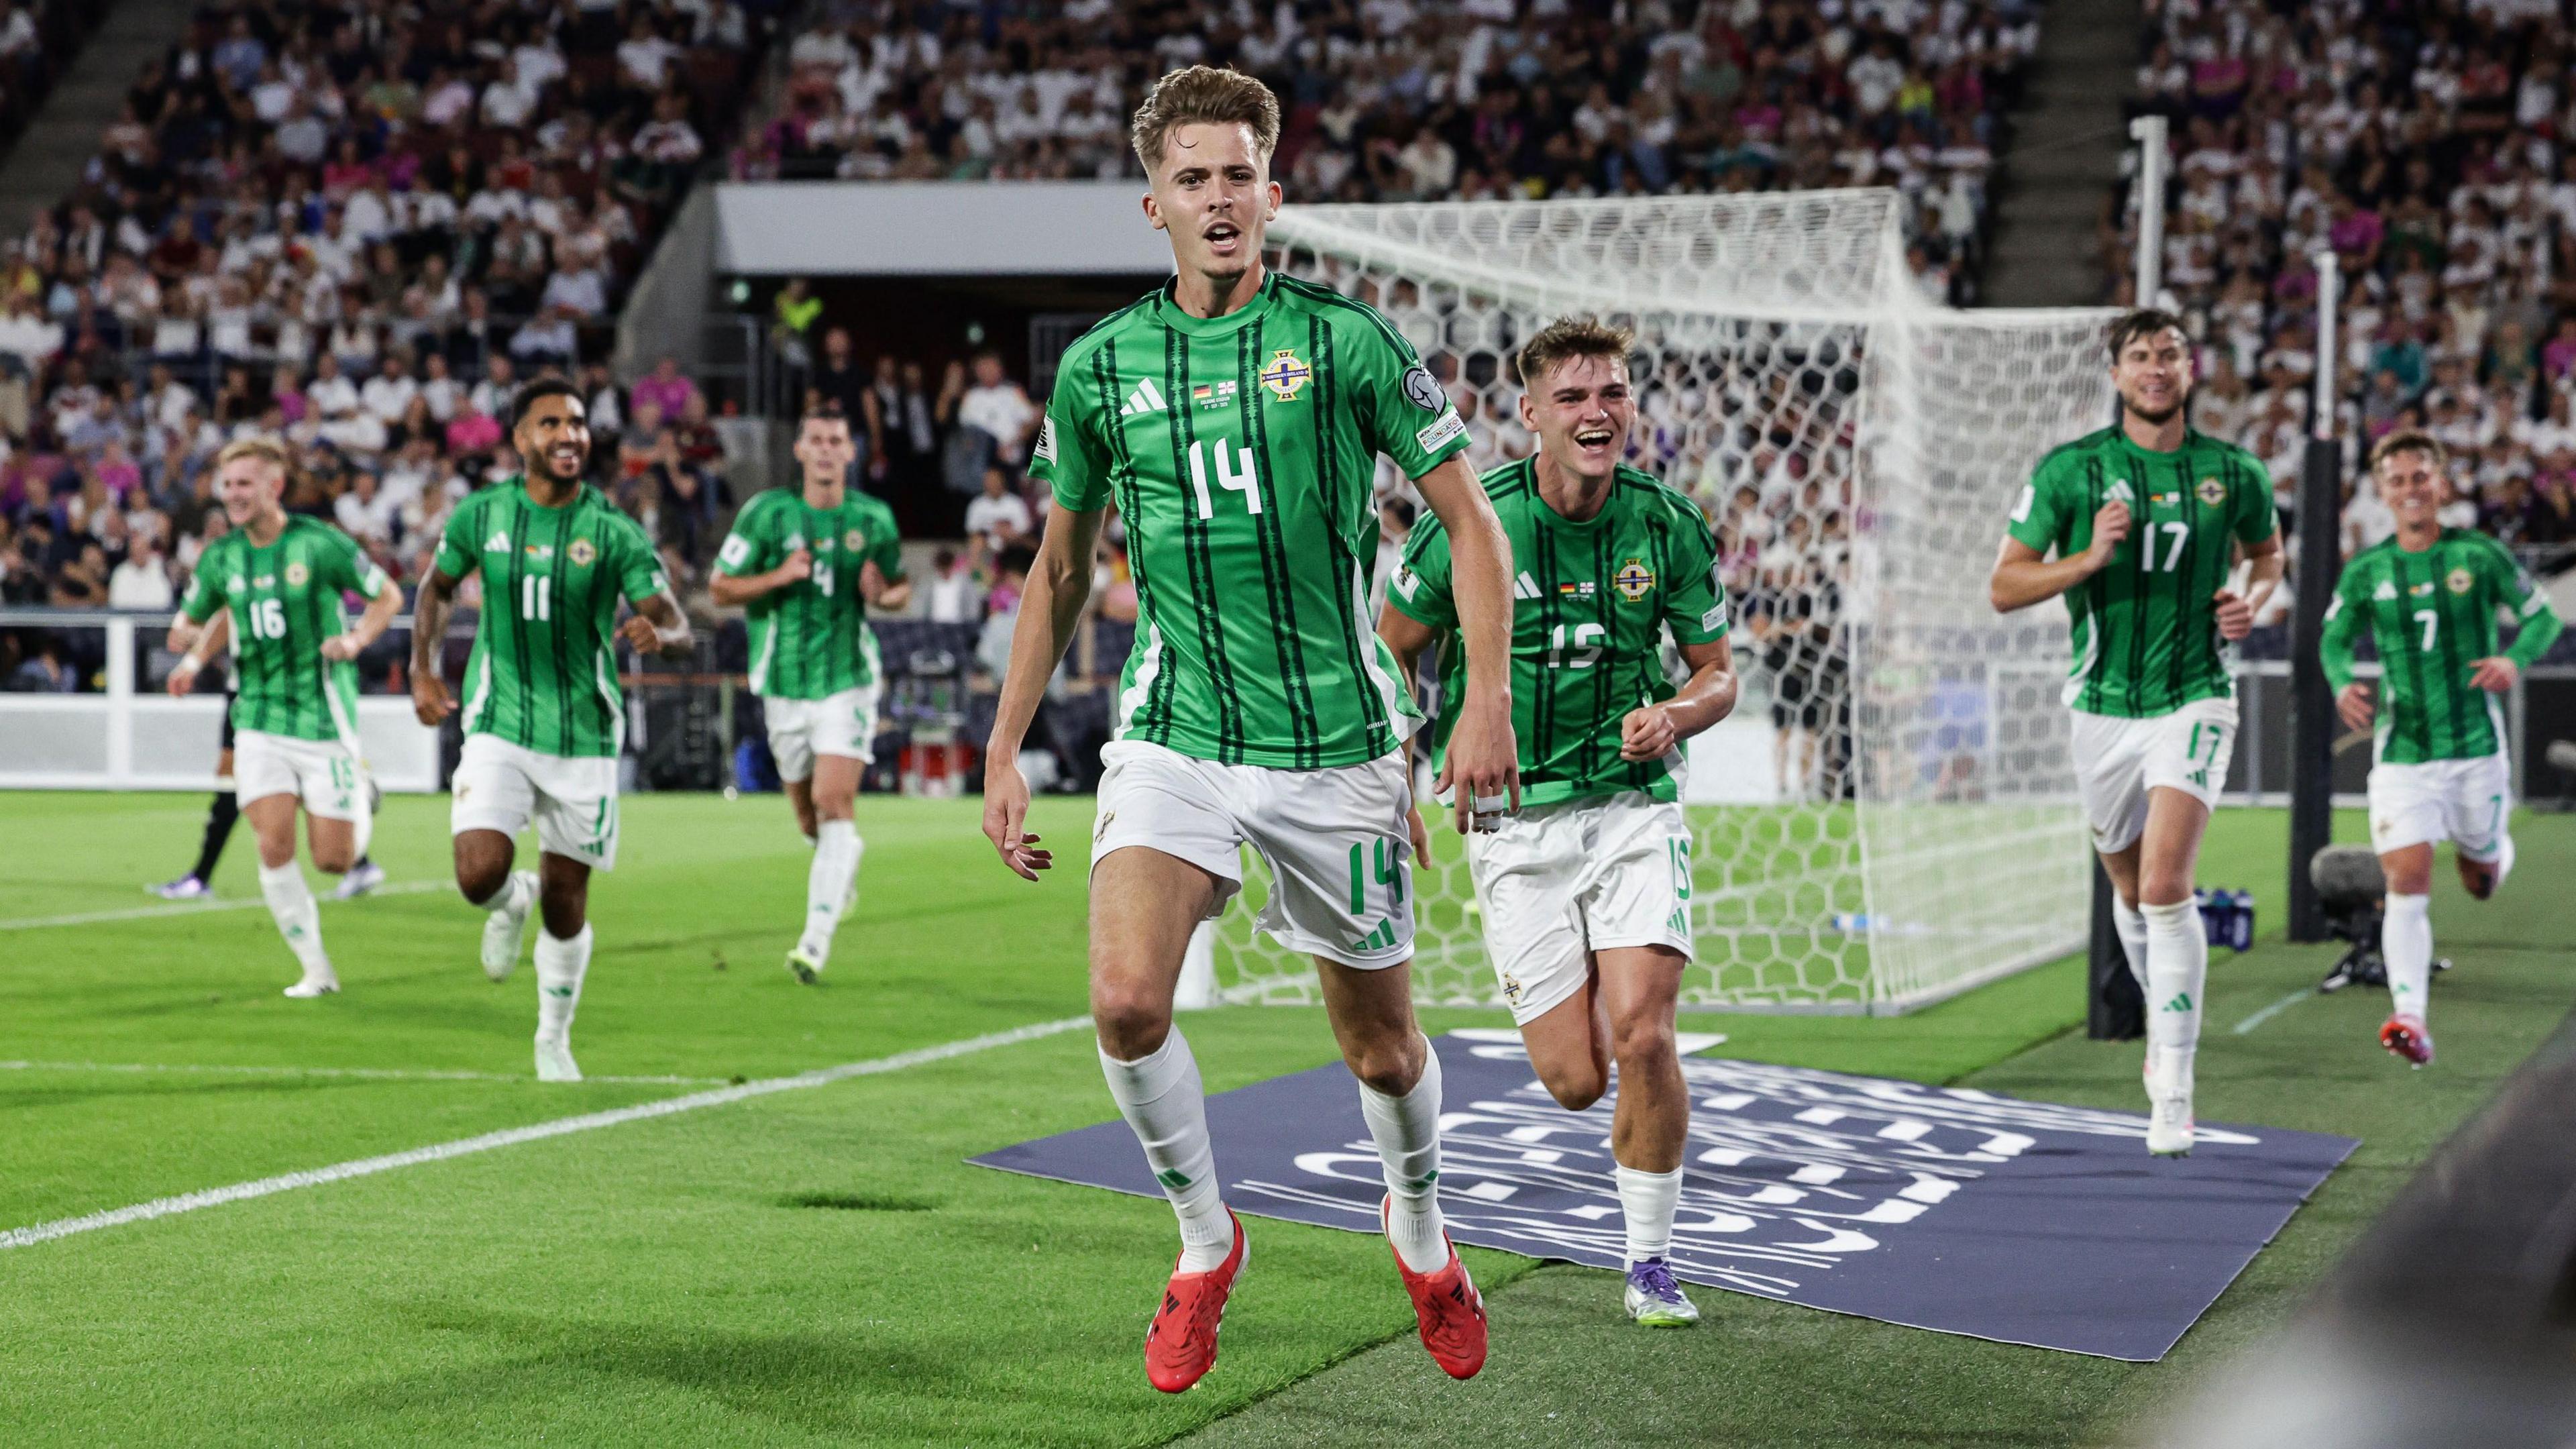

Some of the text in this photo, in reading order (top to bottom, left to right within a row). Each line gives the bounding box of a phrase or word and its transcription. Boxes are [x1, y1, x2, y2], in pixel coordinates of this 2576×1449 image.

[1189, 437, 1262, 520] 14
[2142, 521, 2190, 572] 17
[523, 574, 550, 621] 11
[812, 559, 835, 597] 4
[250, 598, 286, 640] 16
[2413, 609, 2438, 652] 7
[1548, 623, 1605, 668] 15
[2188, 722, 2221, 766] 17
[1350, 836, 1403, 915] 14
[1668, 837, 1690, 900] 15
